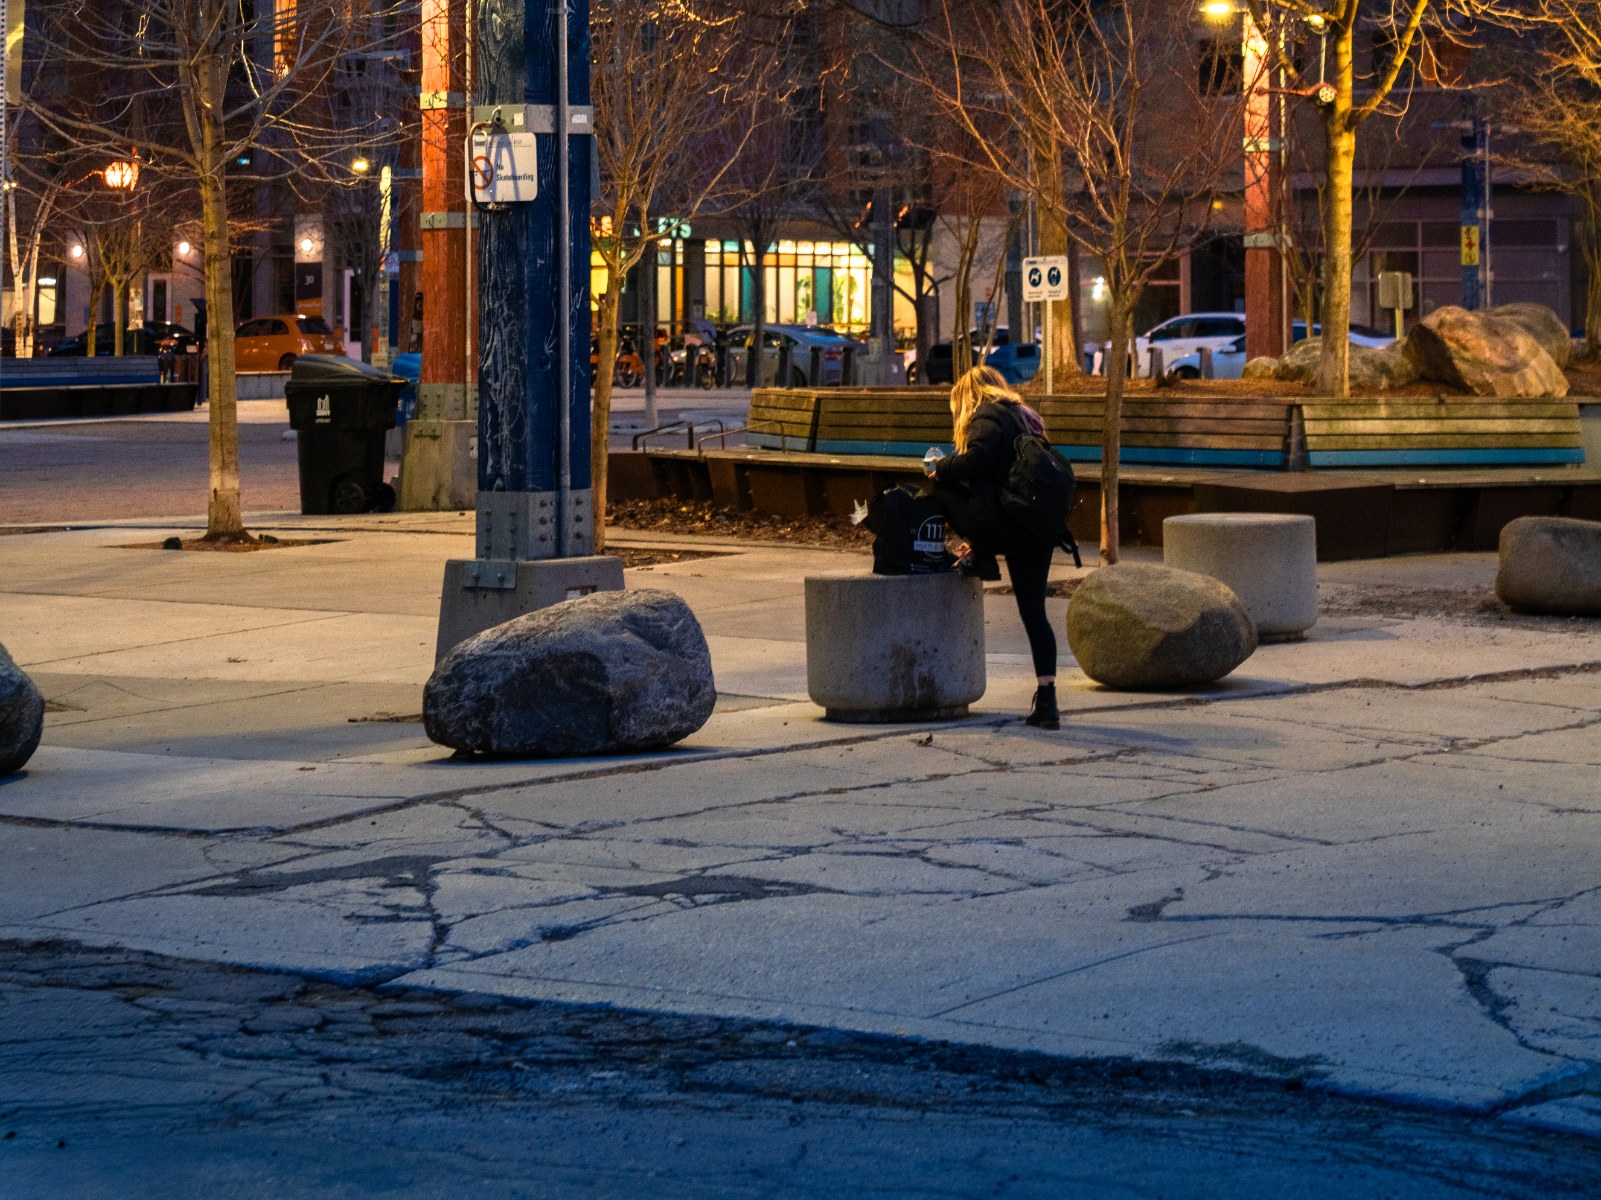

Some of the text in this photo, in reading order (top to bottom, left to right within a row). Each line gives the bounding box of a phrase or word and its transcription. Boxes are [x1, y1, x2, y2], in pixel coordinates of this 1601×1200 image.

[496, 163, 504, 171] No
[496, 173, 534, 182] Skateboarding
[926, 523, 944, 539] 111
